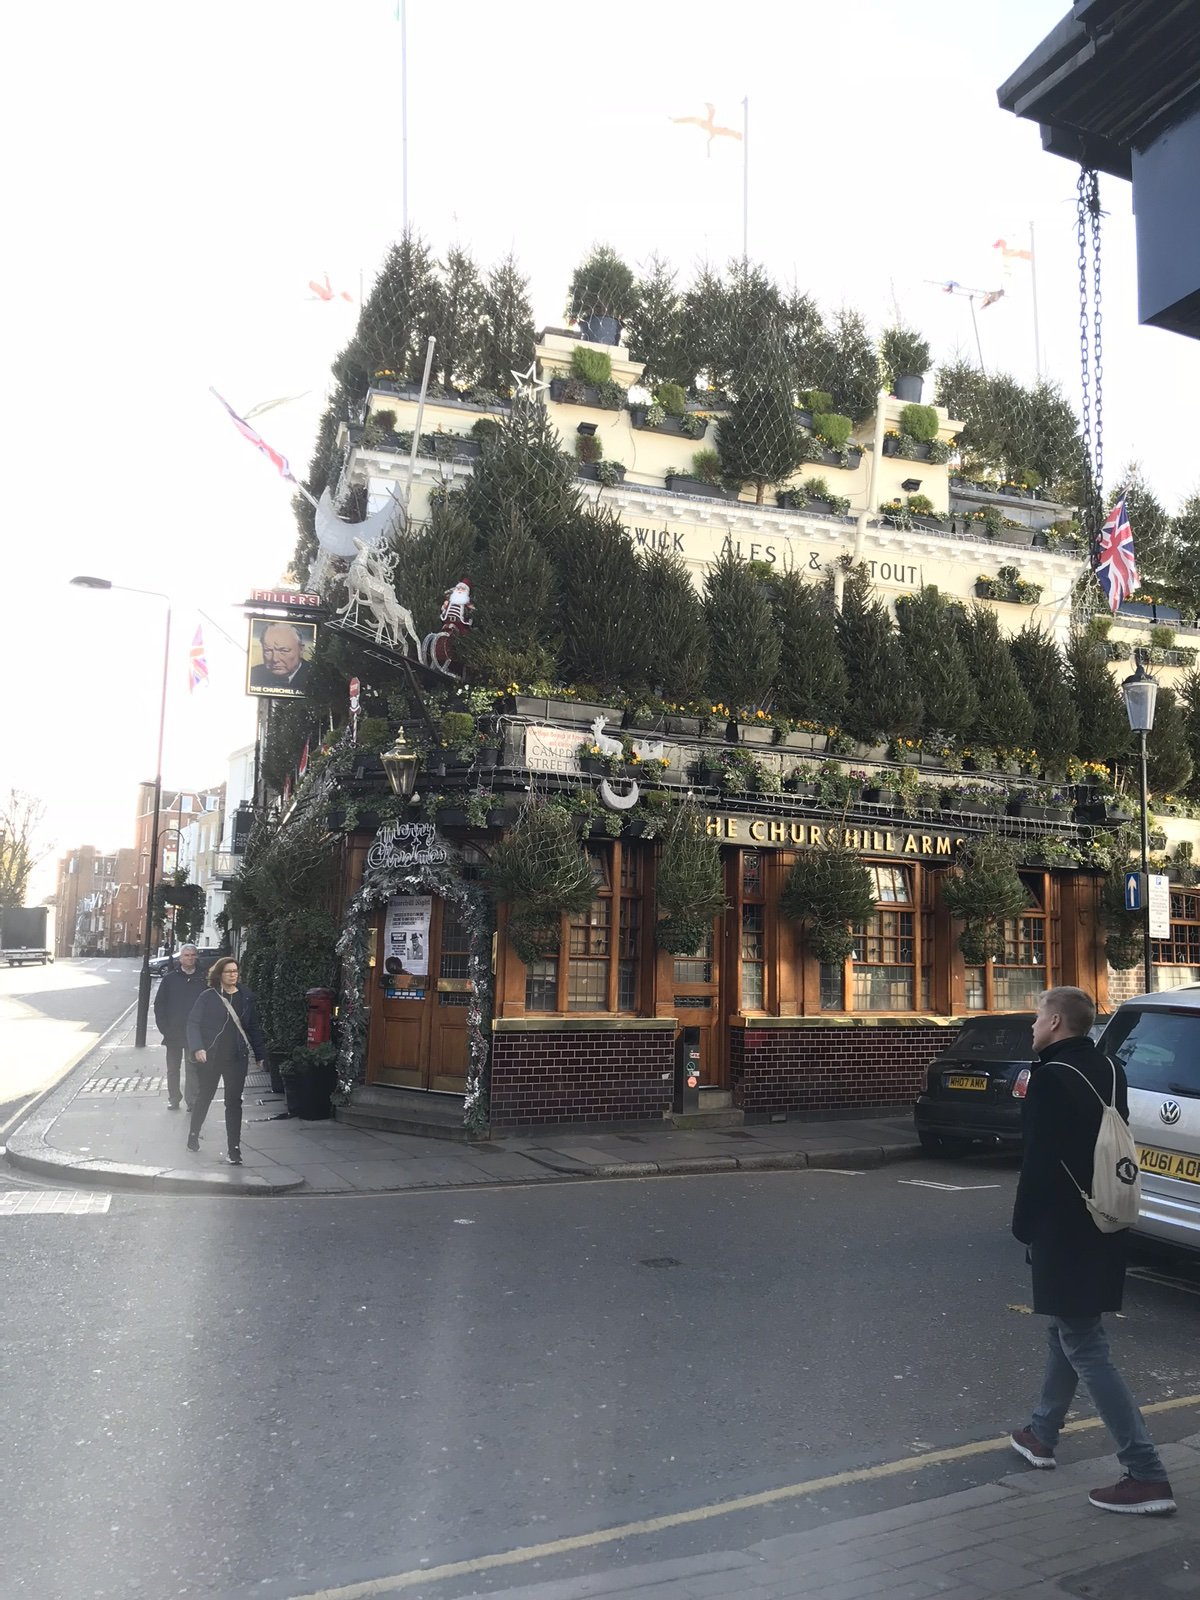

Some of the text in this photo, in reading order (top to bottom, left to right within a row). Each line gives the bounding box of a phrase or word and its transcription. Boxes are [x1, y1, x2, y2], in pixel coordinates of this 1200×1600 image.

[621, 526, 917, 584] SWICK ALES & TOUT
[262, 686, 294, 695] CHURCHILL
[528, 757, 570, 771] STREET
[532, 745, 576, 759] CAMPD
[376, 819, 436, 847] Merry
[750, 820, 896, 851] CHURCHILL
[367, 836, 447, 870] Christmas
[1140, 1149, 1173, 1171] KU61
